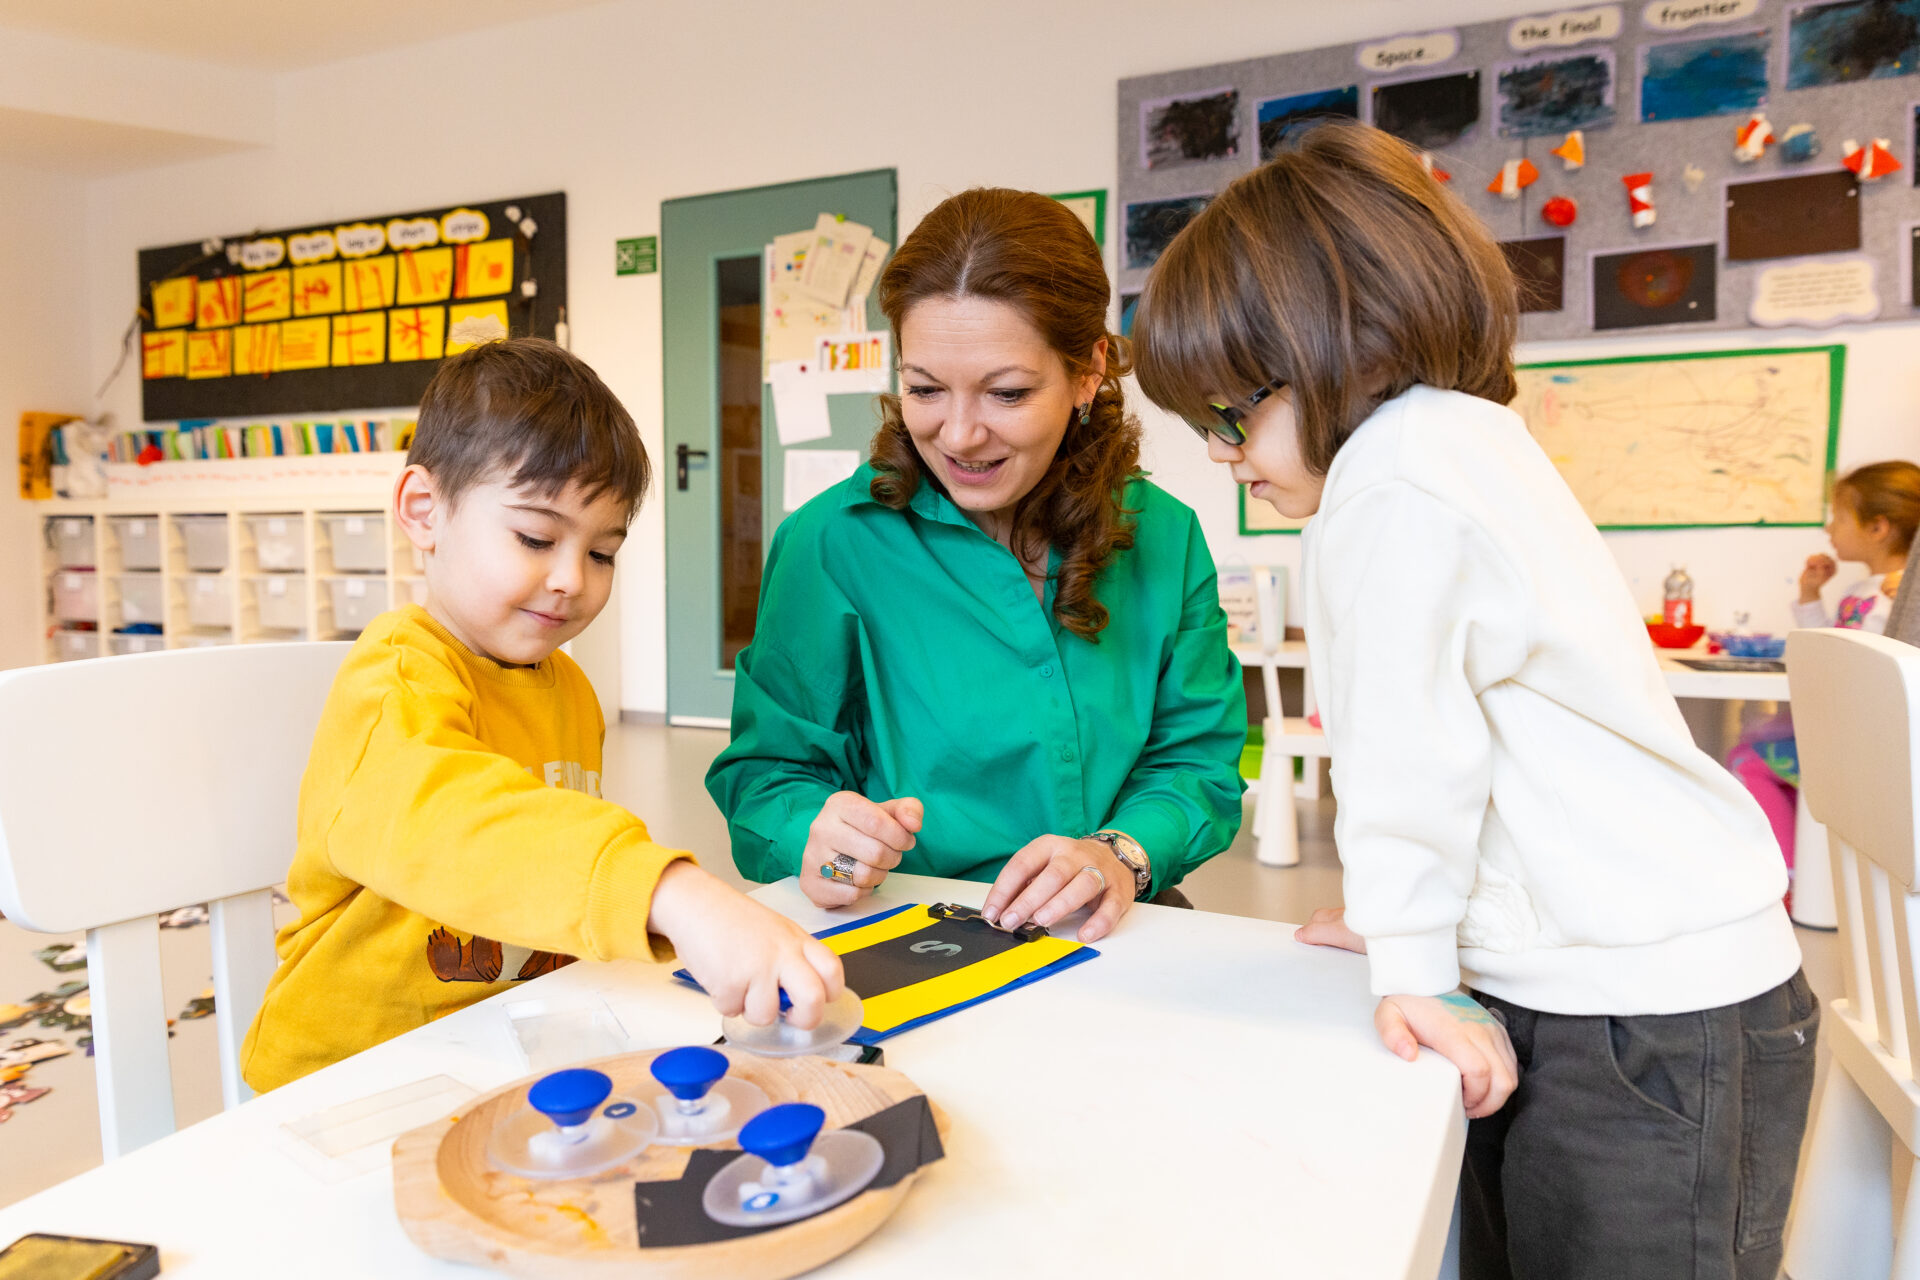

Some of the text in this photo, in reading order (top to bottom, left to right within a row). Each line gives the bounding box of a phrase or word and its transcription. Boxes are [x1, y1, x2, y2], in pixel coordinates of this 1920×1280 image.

[1518, 25, 1550, 39] the
[1560, 15, 1602, 37] final
[1660, 1, 1741, 23] frontier
